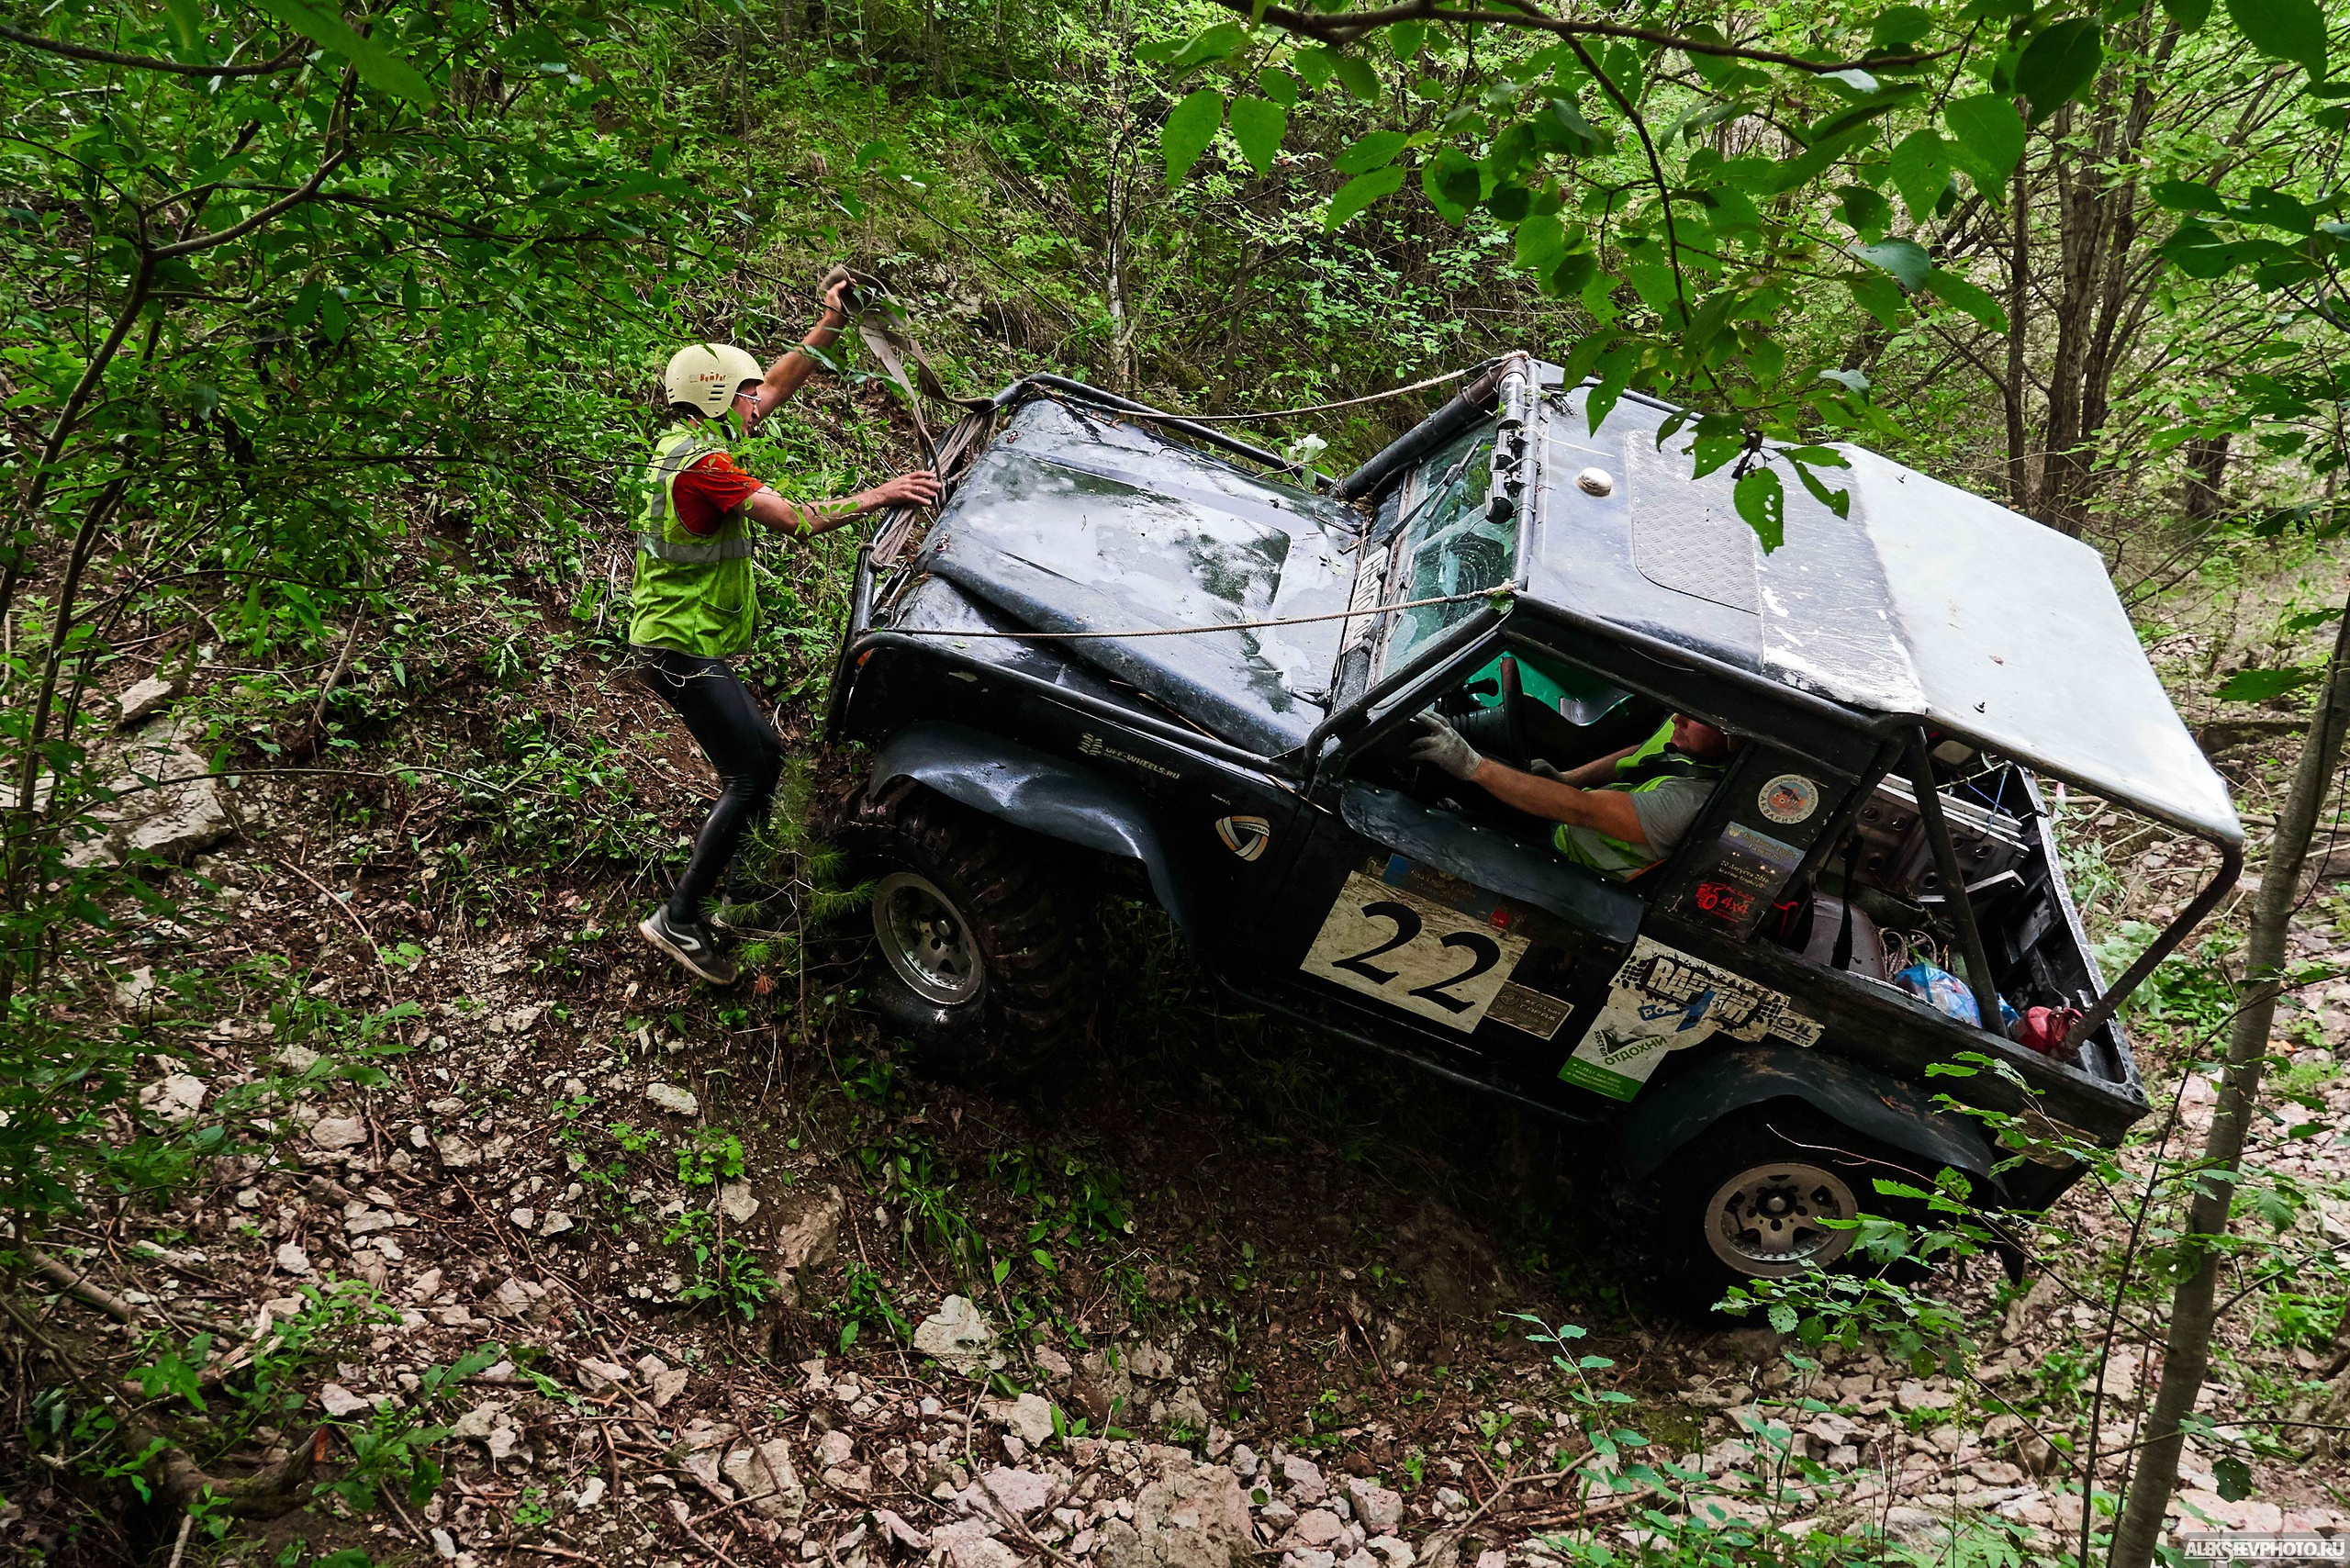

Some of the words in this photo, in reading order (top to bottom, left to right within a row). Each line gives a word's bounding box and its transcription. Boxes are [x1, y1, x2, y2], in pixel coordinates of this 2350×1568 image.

[1104, 746, 1181, 779] OFF-WHEELS.RU
[1331, 901, 1502, 1014] 22
[1519, 1002, 1557, 1022] ГАРАЖ
[1774, 1016, 1813, 1038] OIL
[1605, 1036, 1668, 1066] ОТДОХНИ
